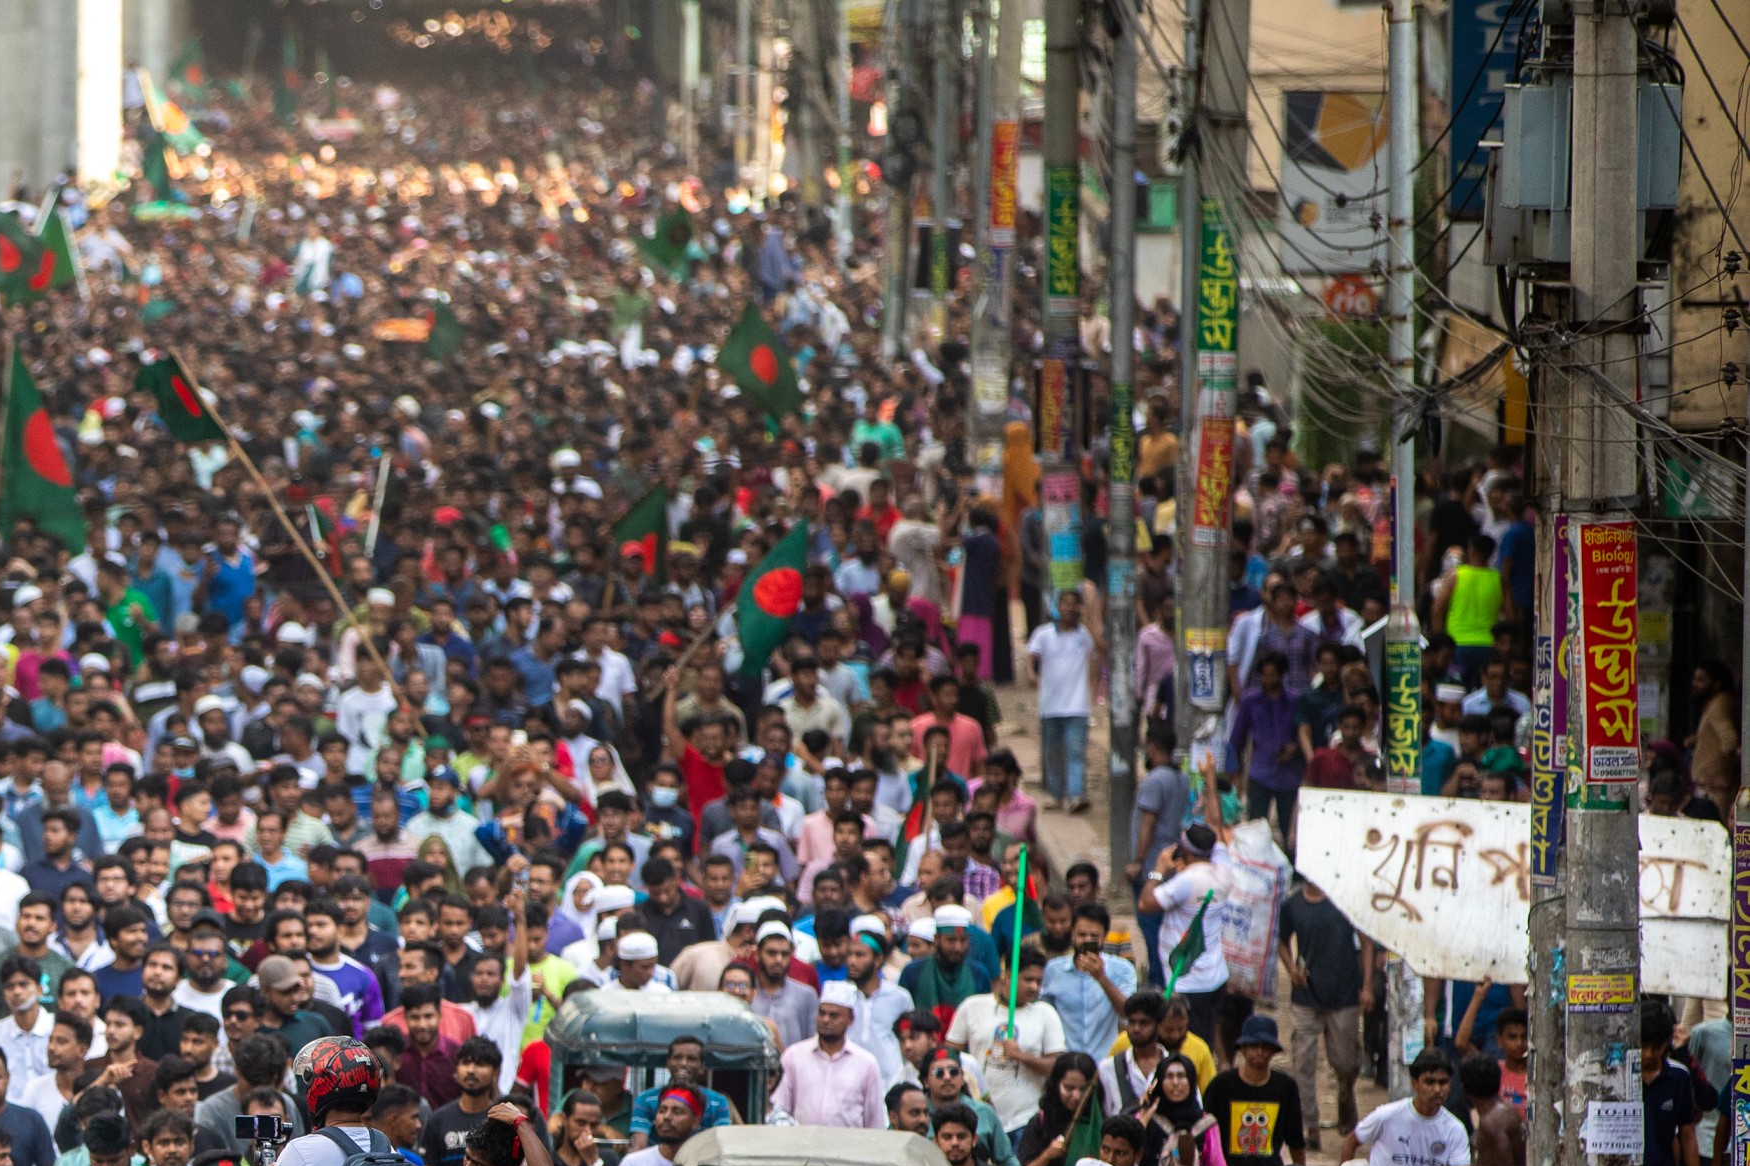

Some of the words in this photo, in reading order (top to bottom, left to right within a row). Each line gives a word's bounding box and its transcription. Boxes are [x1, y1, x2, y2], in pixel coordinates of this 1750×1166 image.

[1592, 549, 1634, 564] Biology
[1366, 819, 1473, 922] খুনি
[1594, 1108, 1642, 1117] TO-LE
